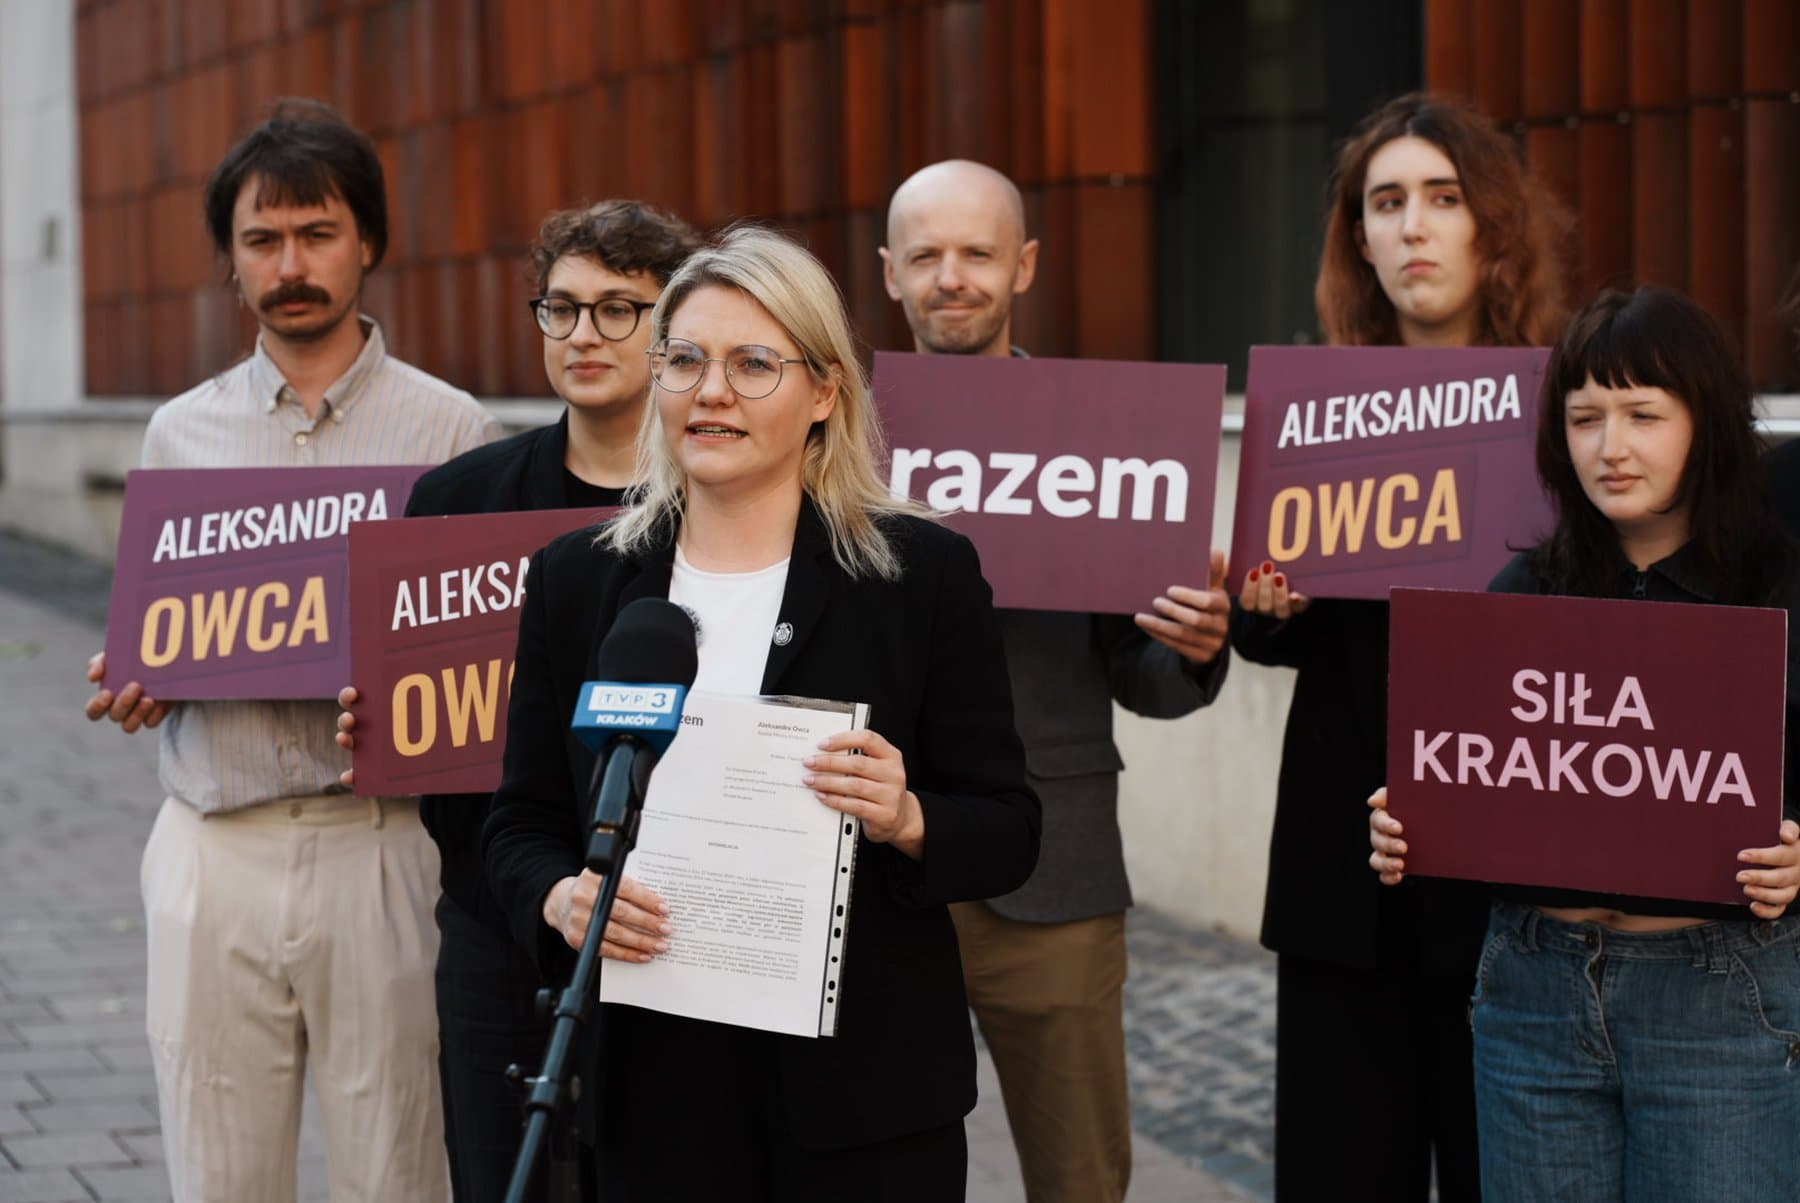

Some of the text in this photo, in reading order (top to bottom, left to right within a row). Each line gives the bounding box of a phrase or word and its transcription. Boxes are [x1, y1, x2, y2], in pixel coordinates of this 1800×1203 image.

[1277, 373, 1521, 449] ALEKSANDRA
[890, 447, 1189, 522] razem
[1267, 468, 1462, 562] OWCA
[152, 488, 388, 563] ALEKSANDRA
[140, 576, 329, 668] OWCA
[392, 658, 515, 757] OW
[596, 713, 659, 726] KRAKÓW
[1510, 668, 1655, 730] SIŁA
[1412, 729, 1756, 807] KRAKOWA
